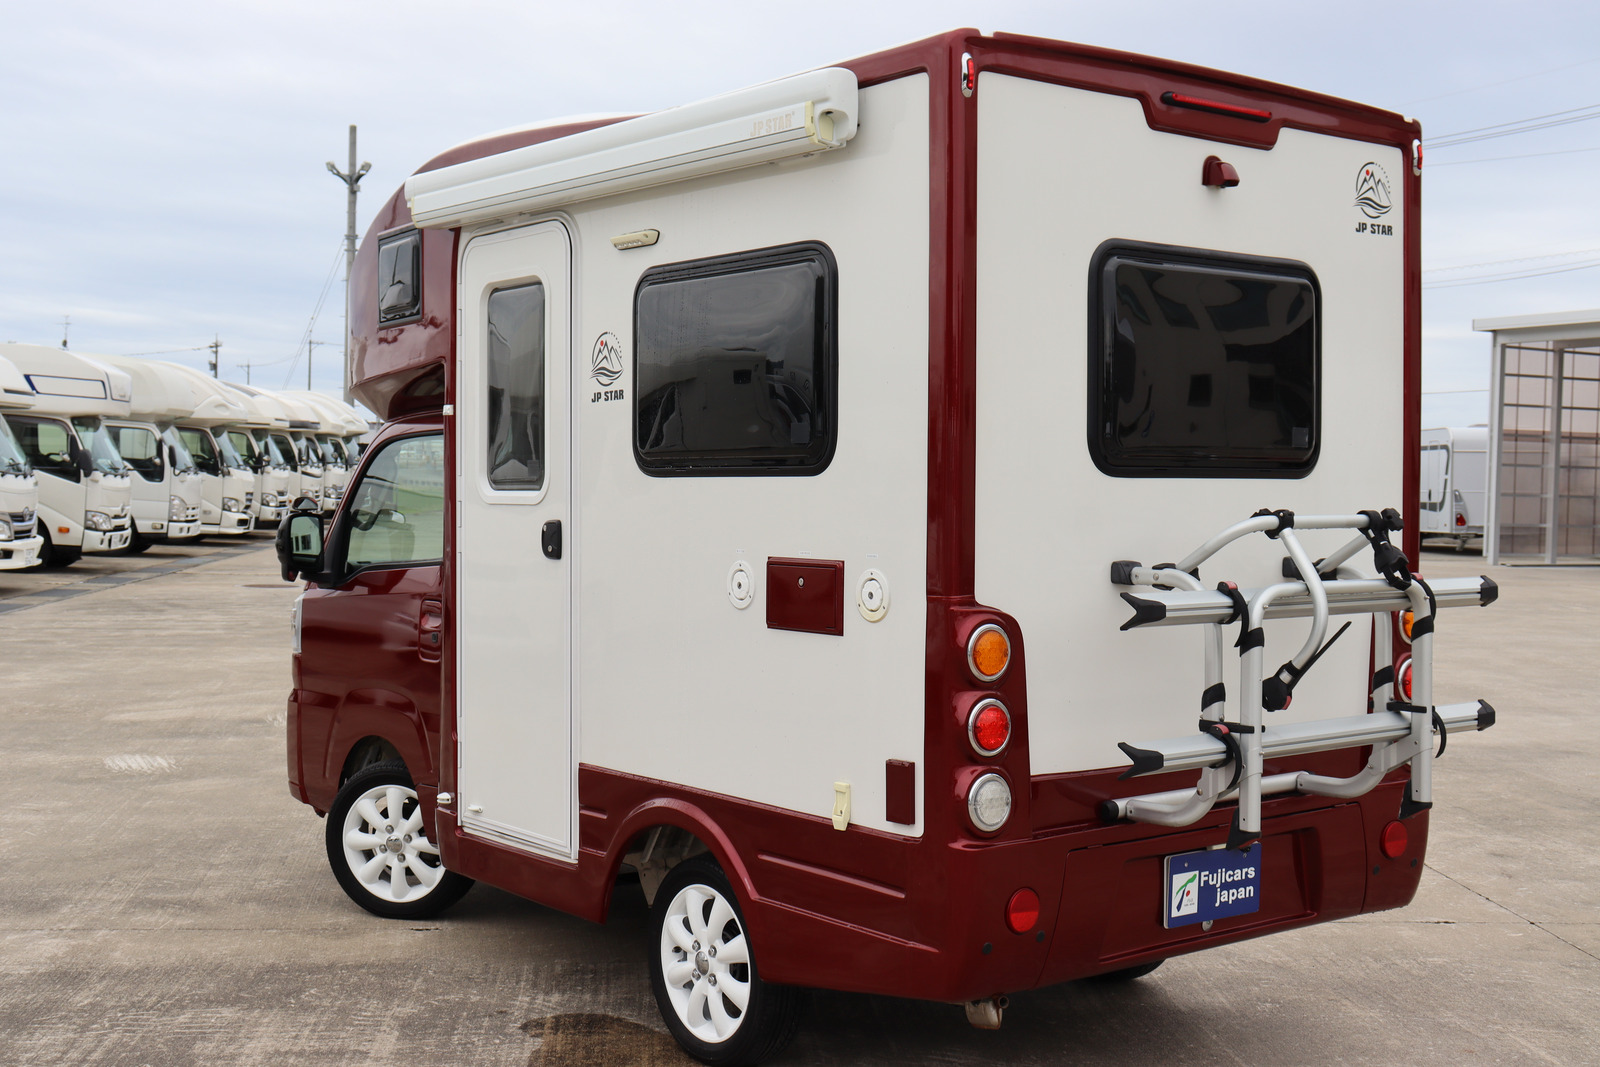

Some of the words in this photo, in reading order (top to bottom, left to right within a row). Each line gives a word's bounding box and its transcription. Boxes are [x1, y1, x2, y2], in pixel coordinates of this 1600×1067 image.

[750, 121, 764, 137] JP
[1355, 222, 1368, 233] JP
[1370, 223, 1393, 236] STAR
[591, 391, 602, 403] JP
[604, 389, 624, 402] STAR
[1200, 866, 1256, 888] Fujicars
[1214, 885, 1254, 907] japan
